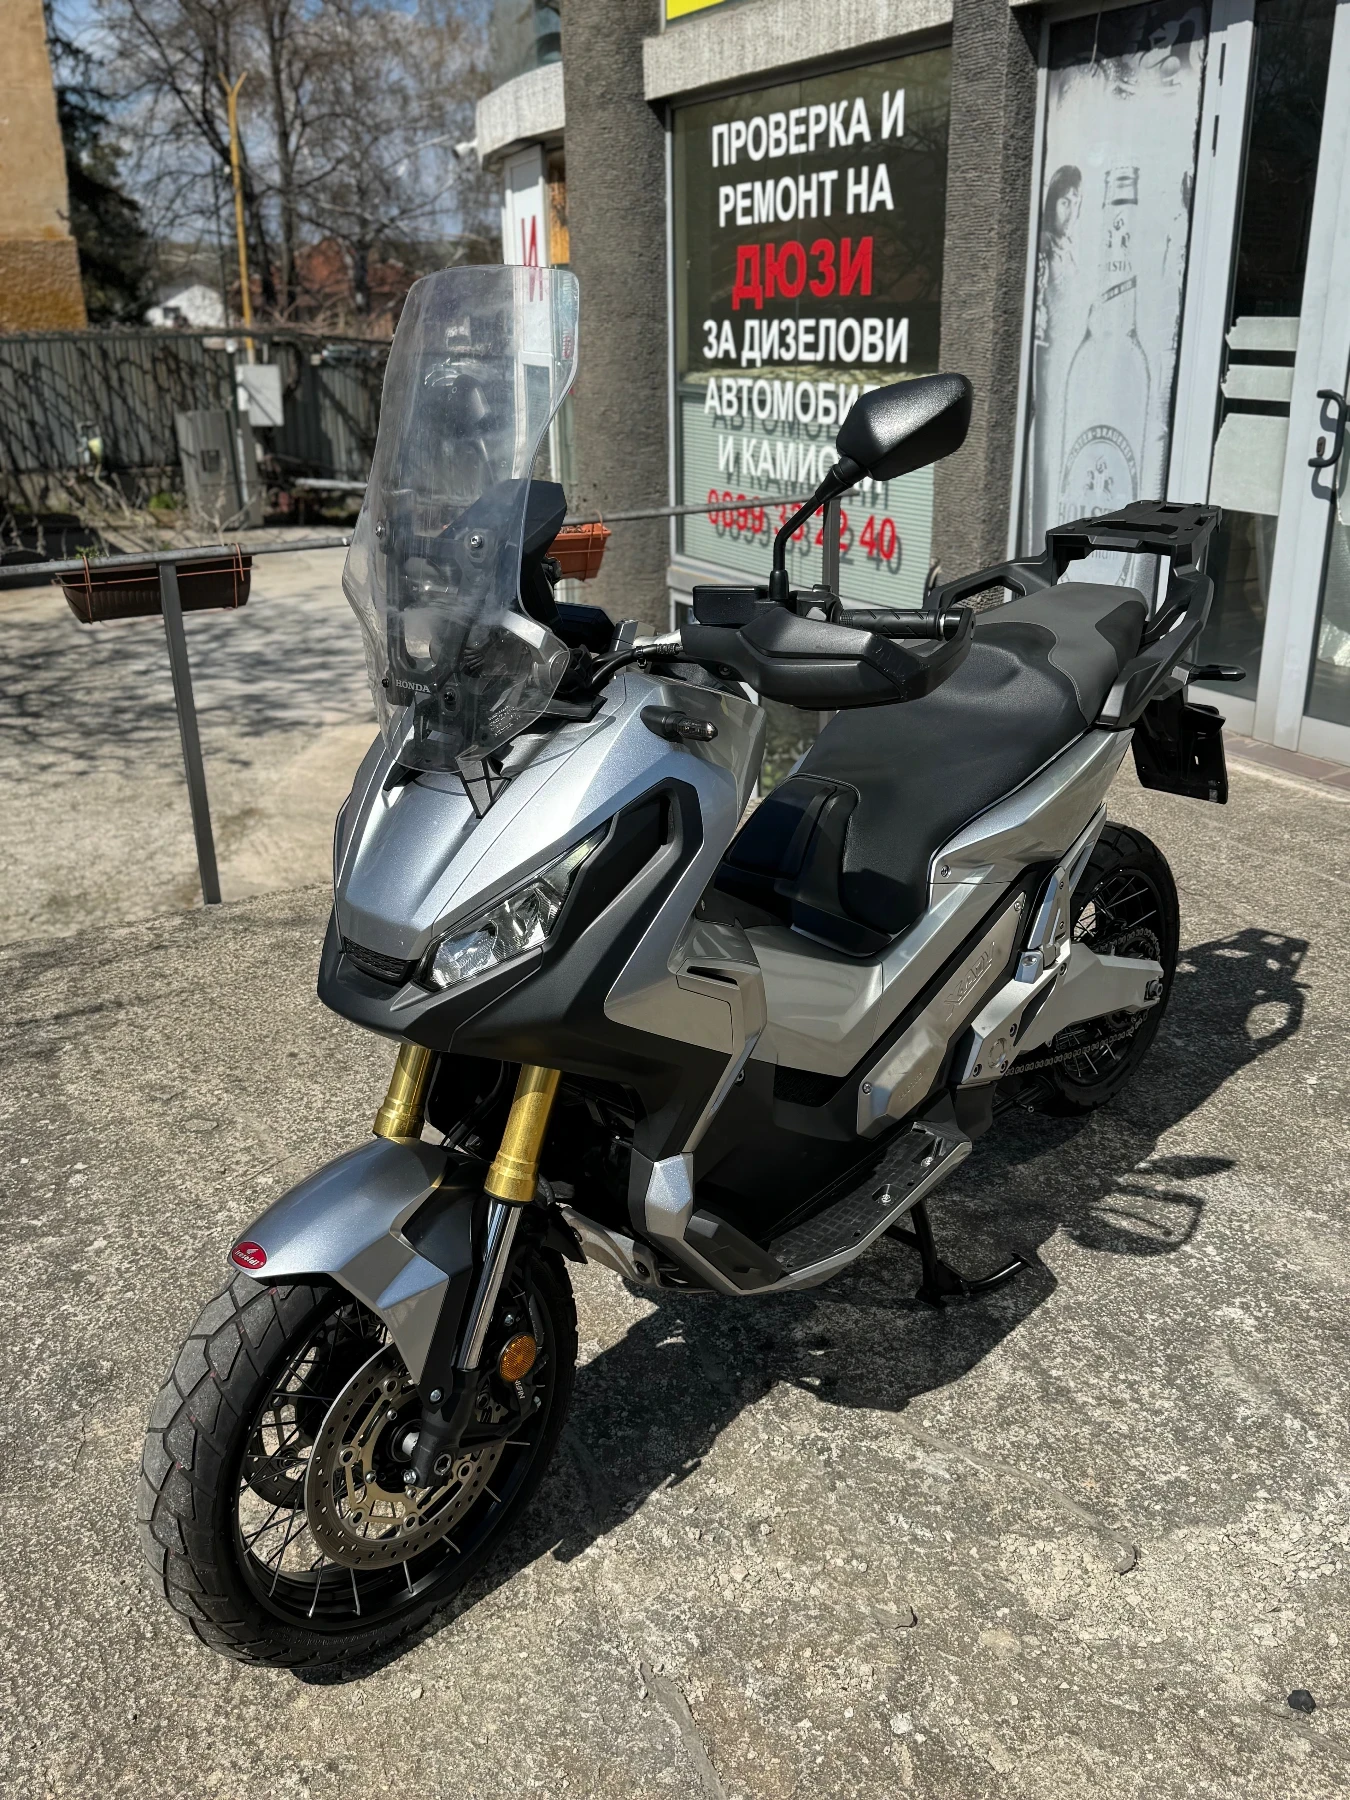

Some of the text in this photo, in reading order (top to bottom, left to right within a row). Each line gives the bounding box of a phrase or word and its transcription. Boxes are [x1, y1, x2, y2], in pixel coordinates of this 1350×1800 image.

[711, 88, 906, 168] ПРОВЕРКА И
[719, 163, 895, 228] РЕМОНТ НА
[731, 235, 874, 311] ДЮЗИ
[702, 317, 909, 369] ЗА ДИЗЕЛОВИ
[703, 376, 881, 426] АВТОМОБИ
[717, 434, 883, 494] И КАМИО
[858, 515, 897, 561] 40
[396, 679, 431, 693] HONDA
